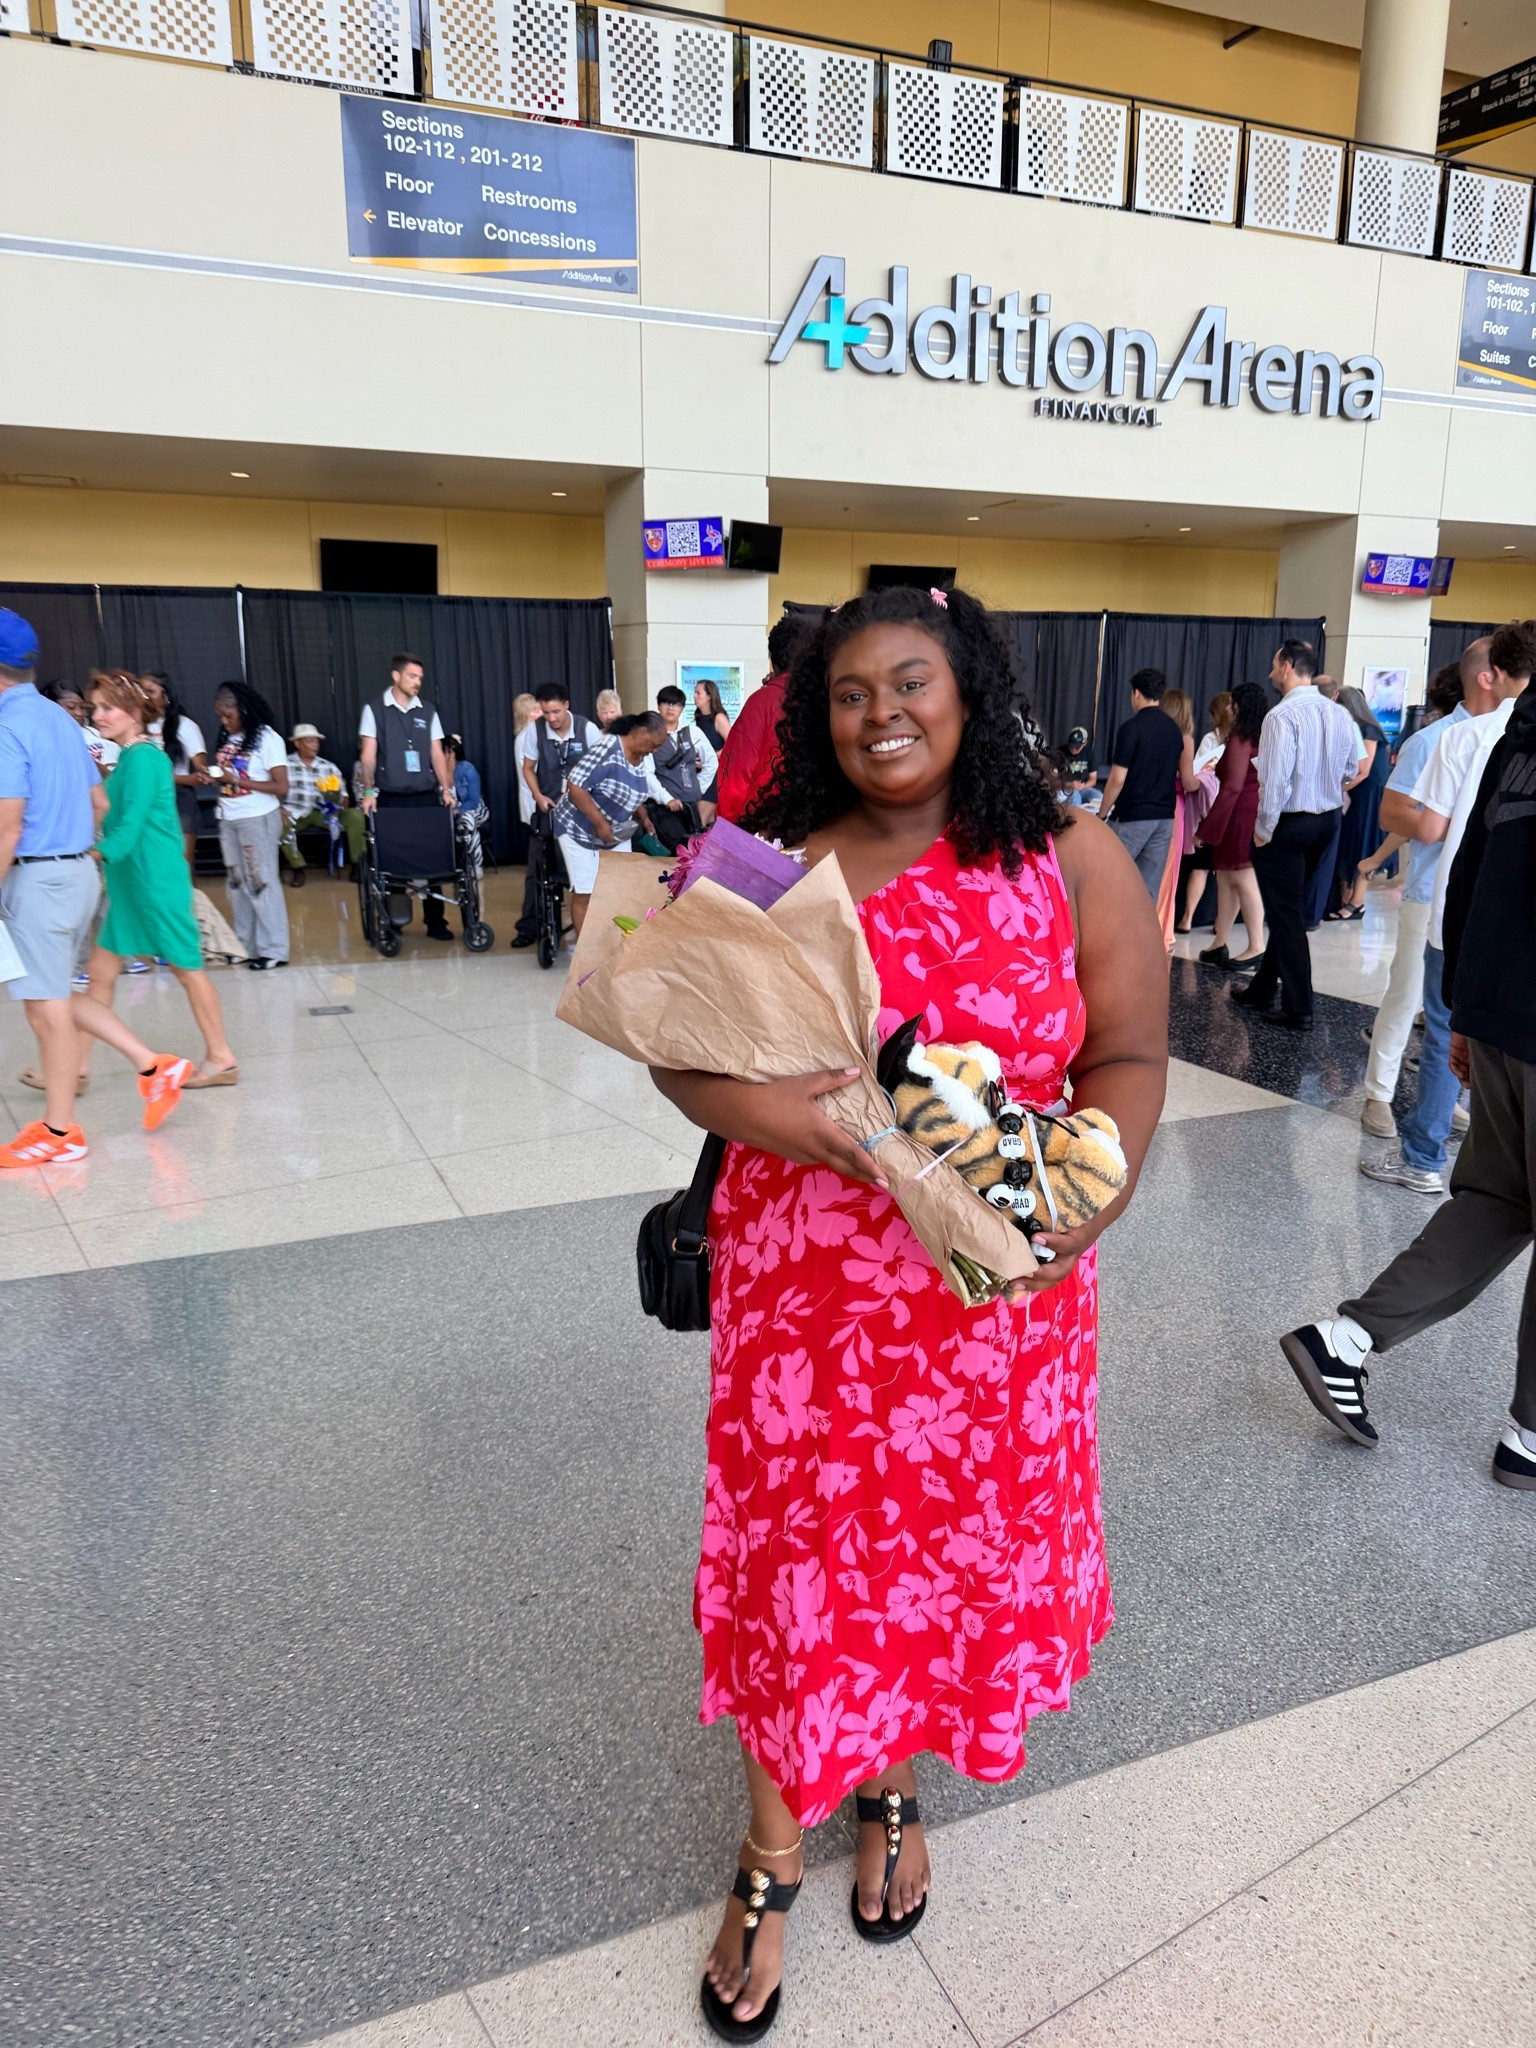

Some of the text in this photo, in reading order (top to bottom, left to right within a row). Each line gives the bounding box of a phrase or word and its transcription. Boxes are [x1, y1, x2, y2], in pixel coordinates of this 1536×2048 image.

[382, 110, 464, 139] Sections
[385, 172, 578, 214] Floor Restrooms
[387, 210, 598, 253] Elevator Concessions
[1487, 279, 1530, 298] Sections
[765, 255, 1385, 421] Addition Arena
[1482, 320, 1509, 336] Floor
[1480, 349, 1511, 365] Suites
[1034, 397, 1162, 428] FINANCIAL
[647, 557, 687, 568] CEREMONY
[689, 557, 706, 567] LIVE
[1002, 1138, 1022, 1146] GRAD
